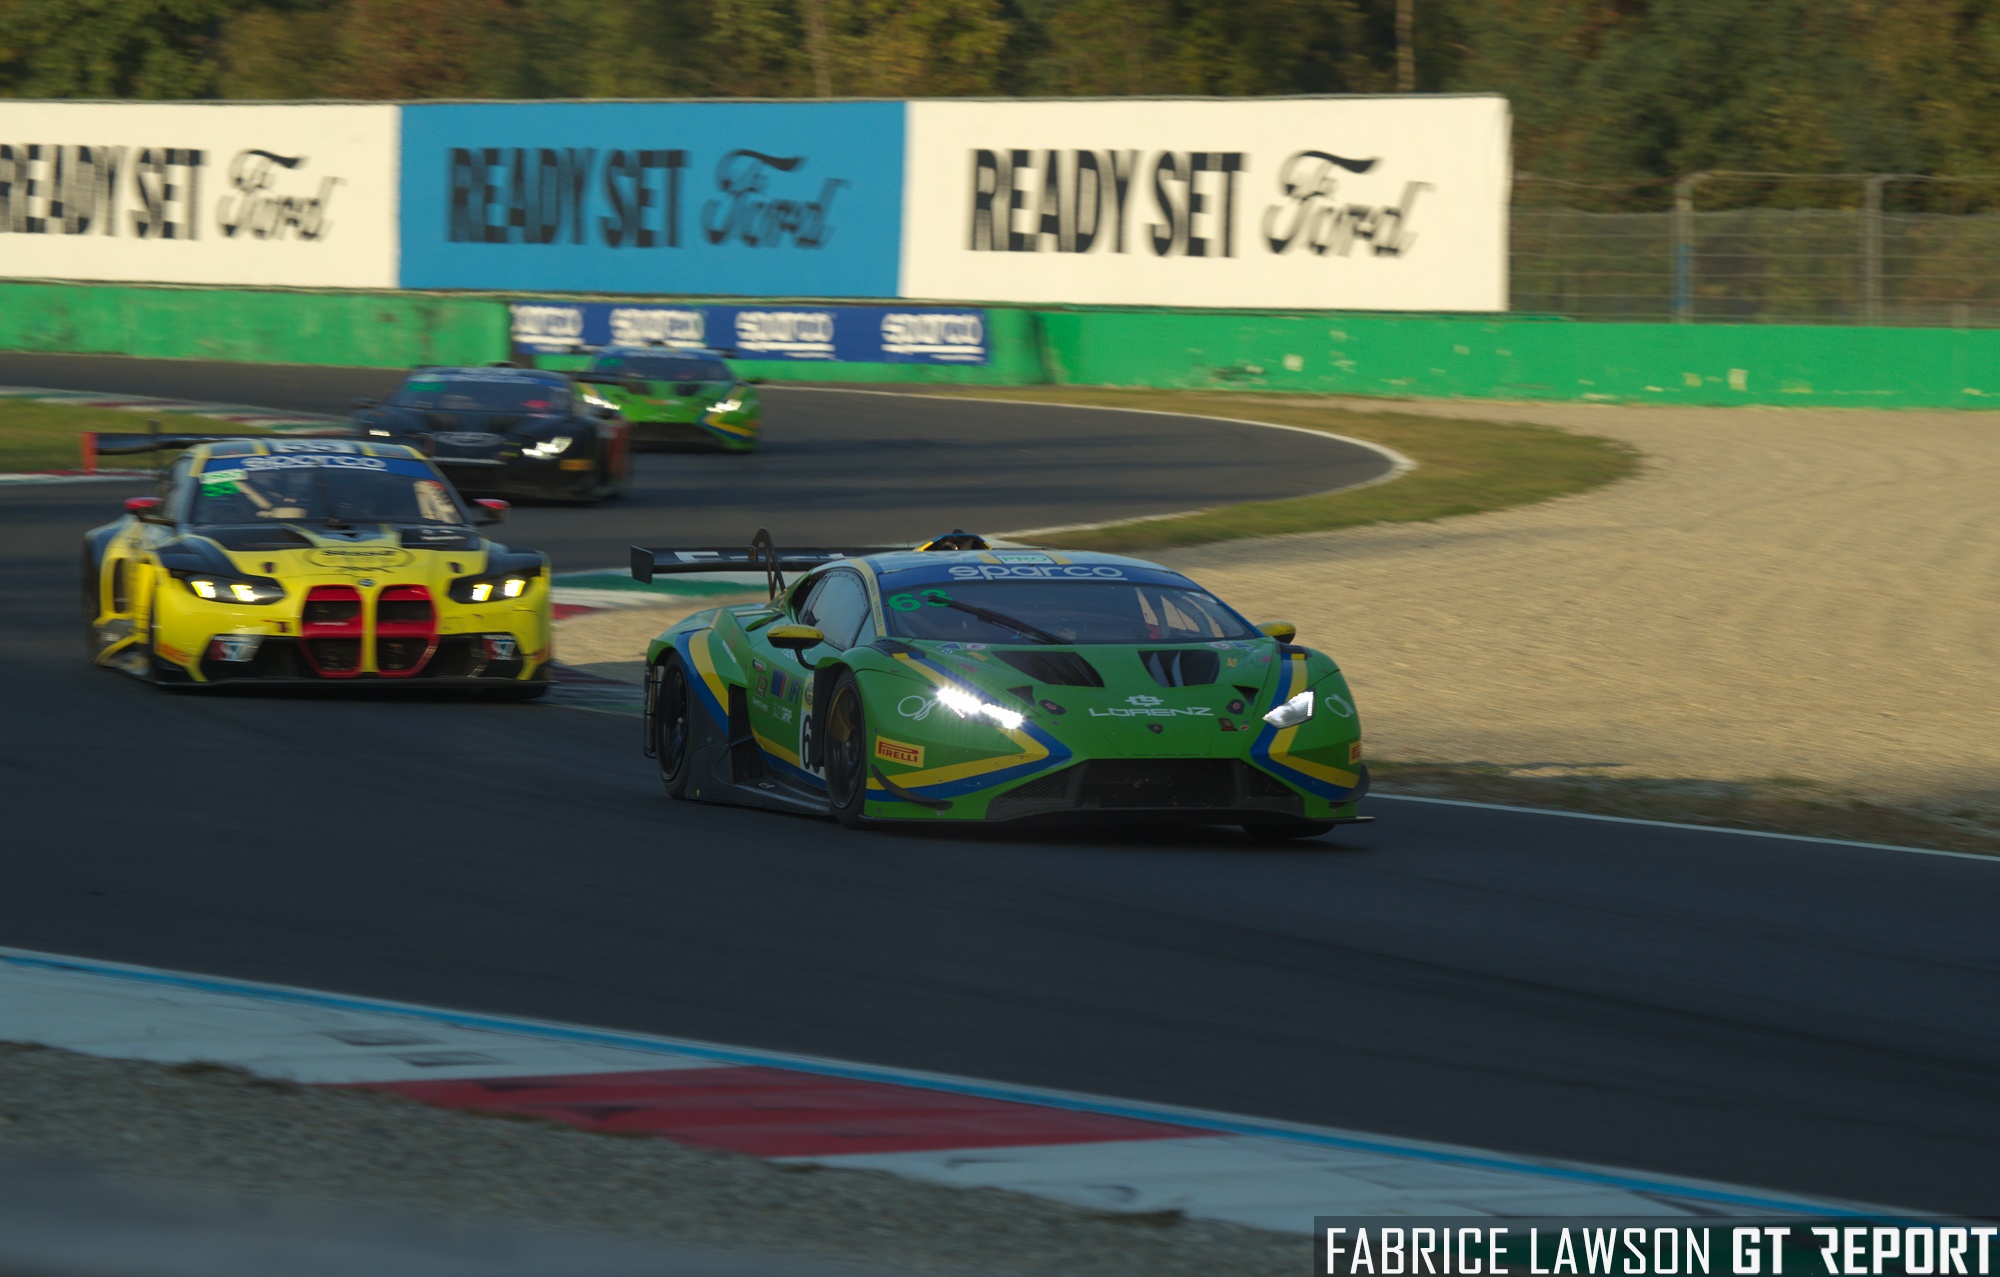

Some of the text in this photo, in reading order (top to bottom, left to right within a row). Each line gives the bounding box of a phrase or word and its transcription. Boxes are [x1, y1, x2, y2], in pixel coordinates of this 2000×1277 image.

[0, 143, 346, 240] READY SET Ford
[447, 147, 852, 249] READY SET Ford
[965, 148, 1437, 258] READY SET Ford
[948, 565, 1128, 580] sparco
[888, 589, 954, 612] 63
[1088, 706, 1214, 717] LORENZ
[877, 740, 919, 763] PIRELLI
